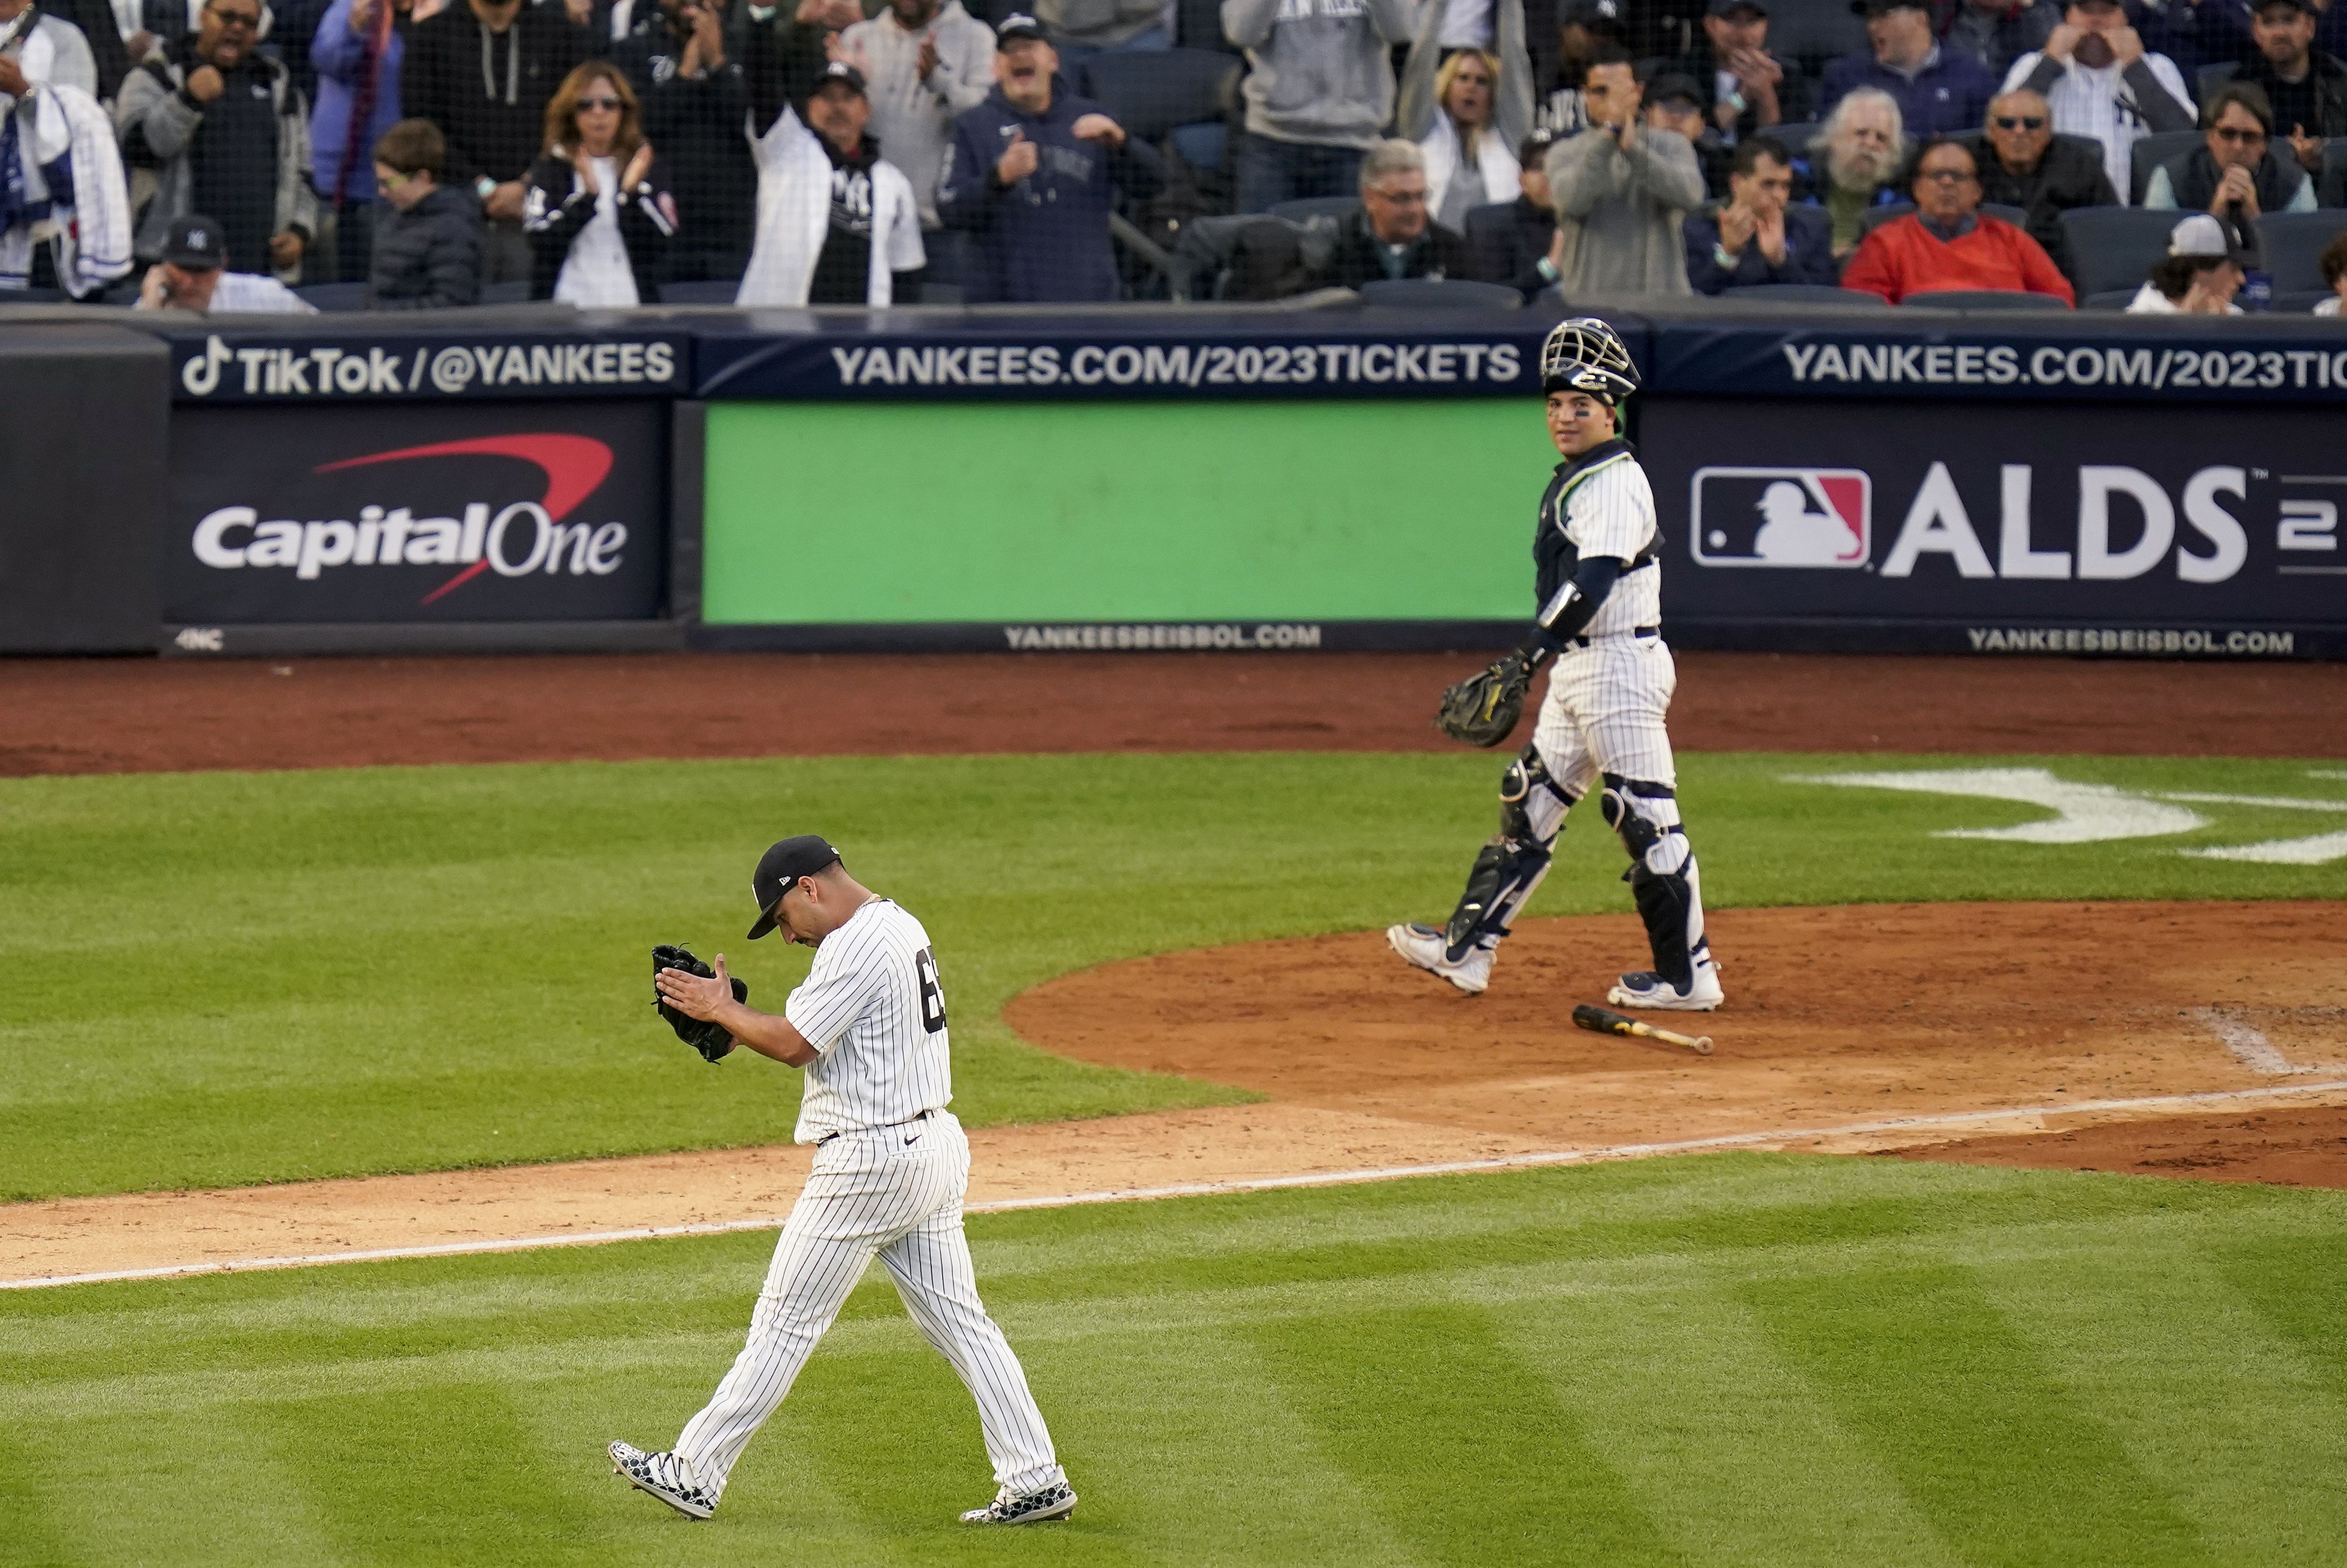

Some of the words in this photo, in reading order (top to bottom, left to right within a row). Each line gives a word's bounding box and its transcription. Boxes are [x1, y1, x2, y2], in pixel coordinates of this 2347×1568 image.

[832, 344, 1520, 386] YANKEES.COM/2023TICKETS
[1880, 462, 2248, 583] ALDS
[1005, 624, 1321, 648] YANKEESBEISBOL.COM
[1969, 628, 2294, 652] YANKEESBEISBOL.COM
